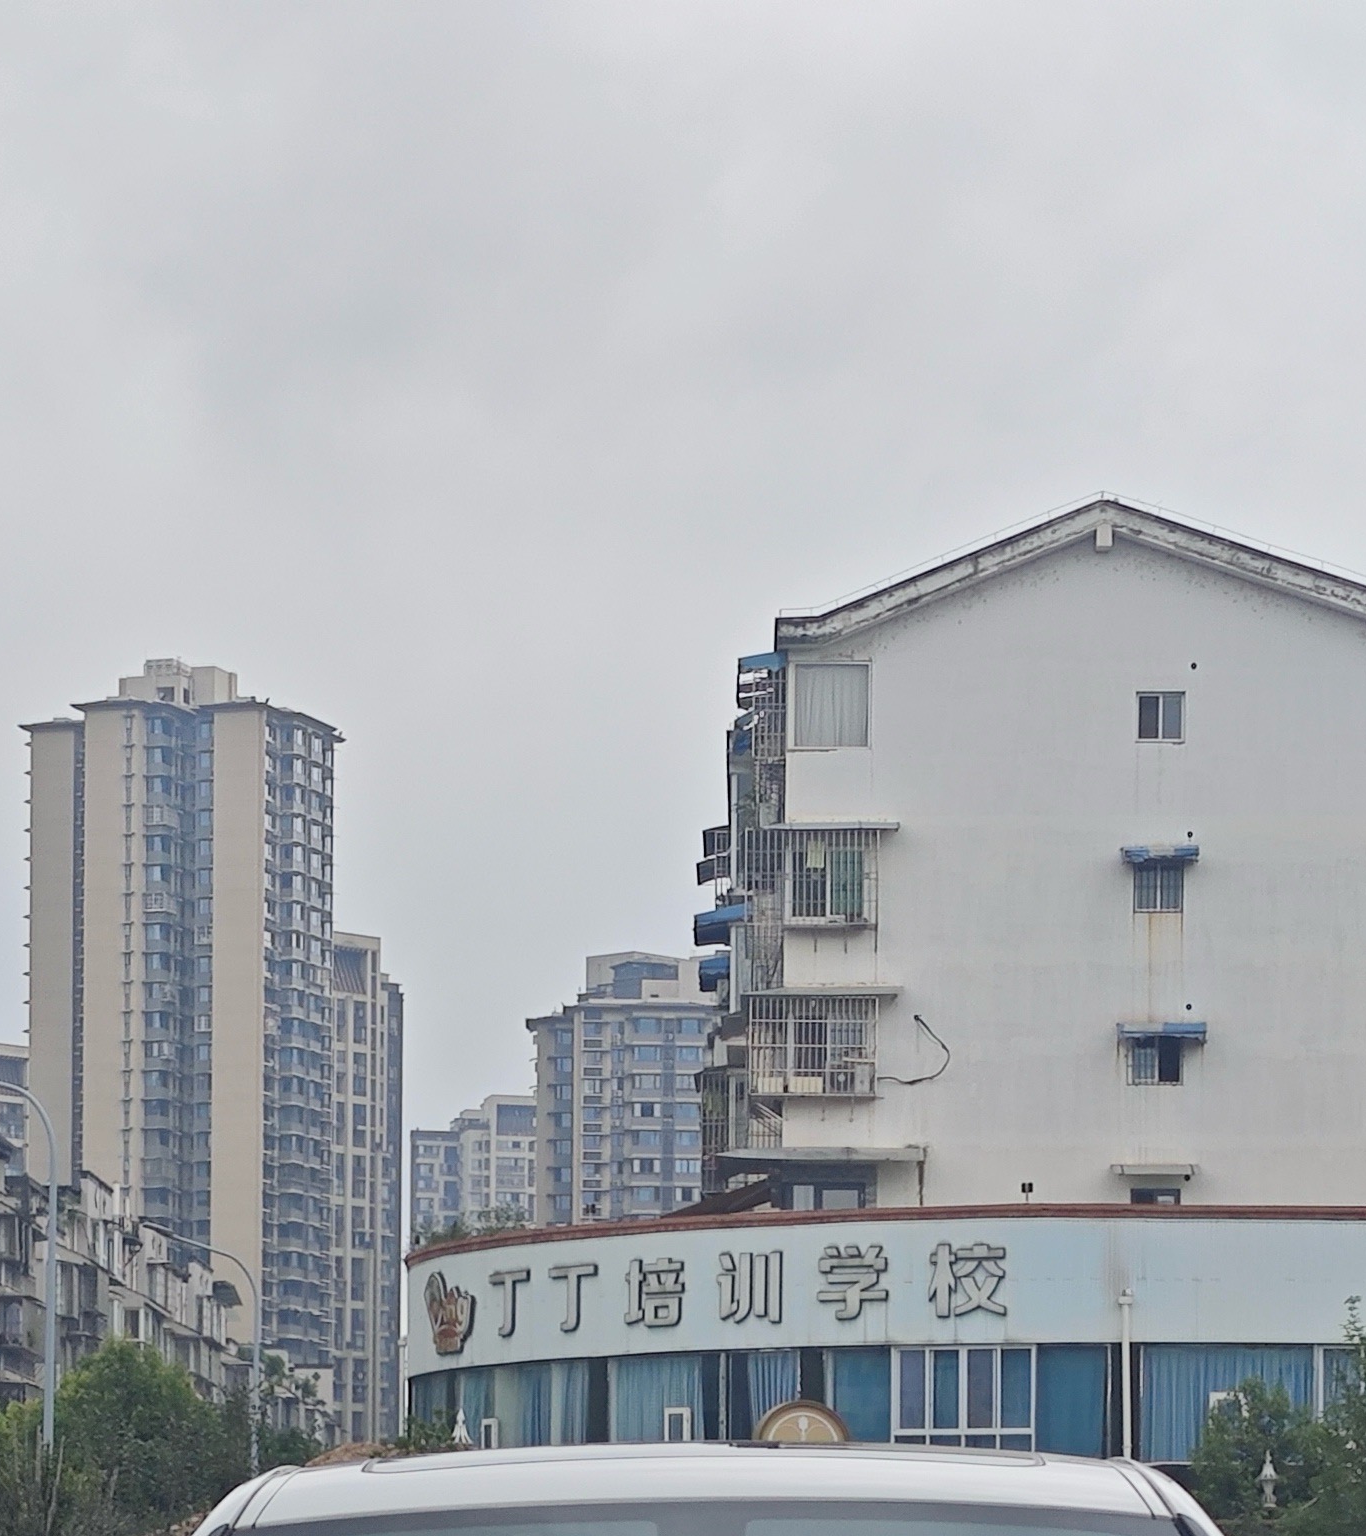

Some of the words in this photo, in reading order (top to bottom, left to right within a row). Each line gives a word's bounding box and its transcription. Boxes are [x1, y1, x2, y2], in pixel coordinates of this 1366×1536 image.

[488, 1242, 1008, 1337] 丁丁培训学校
